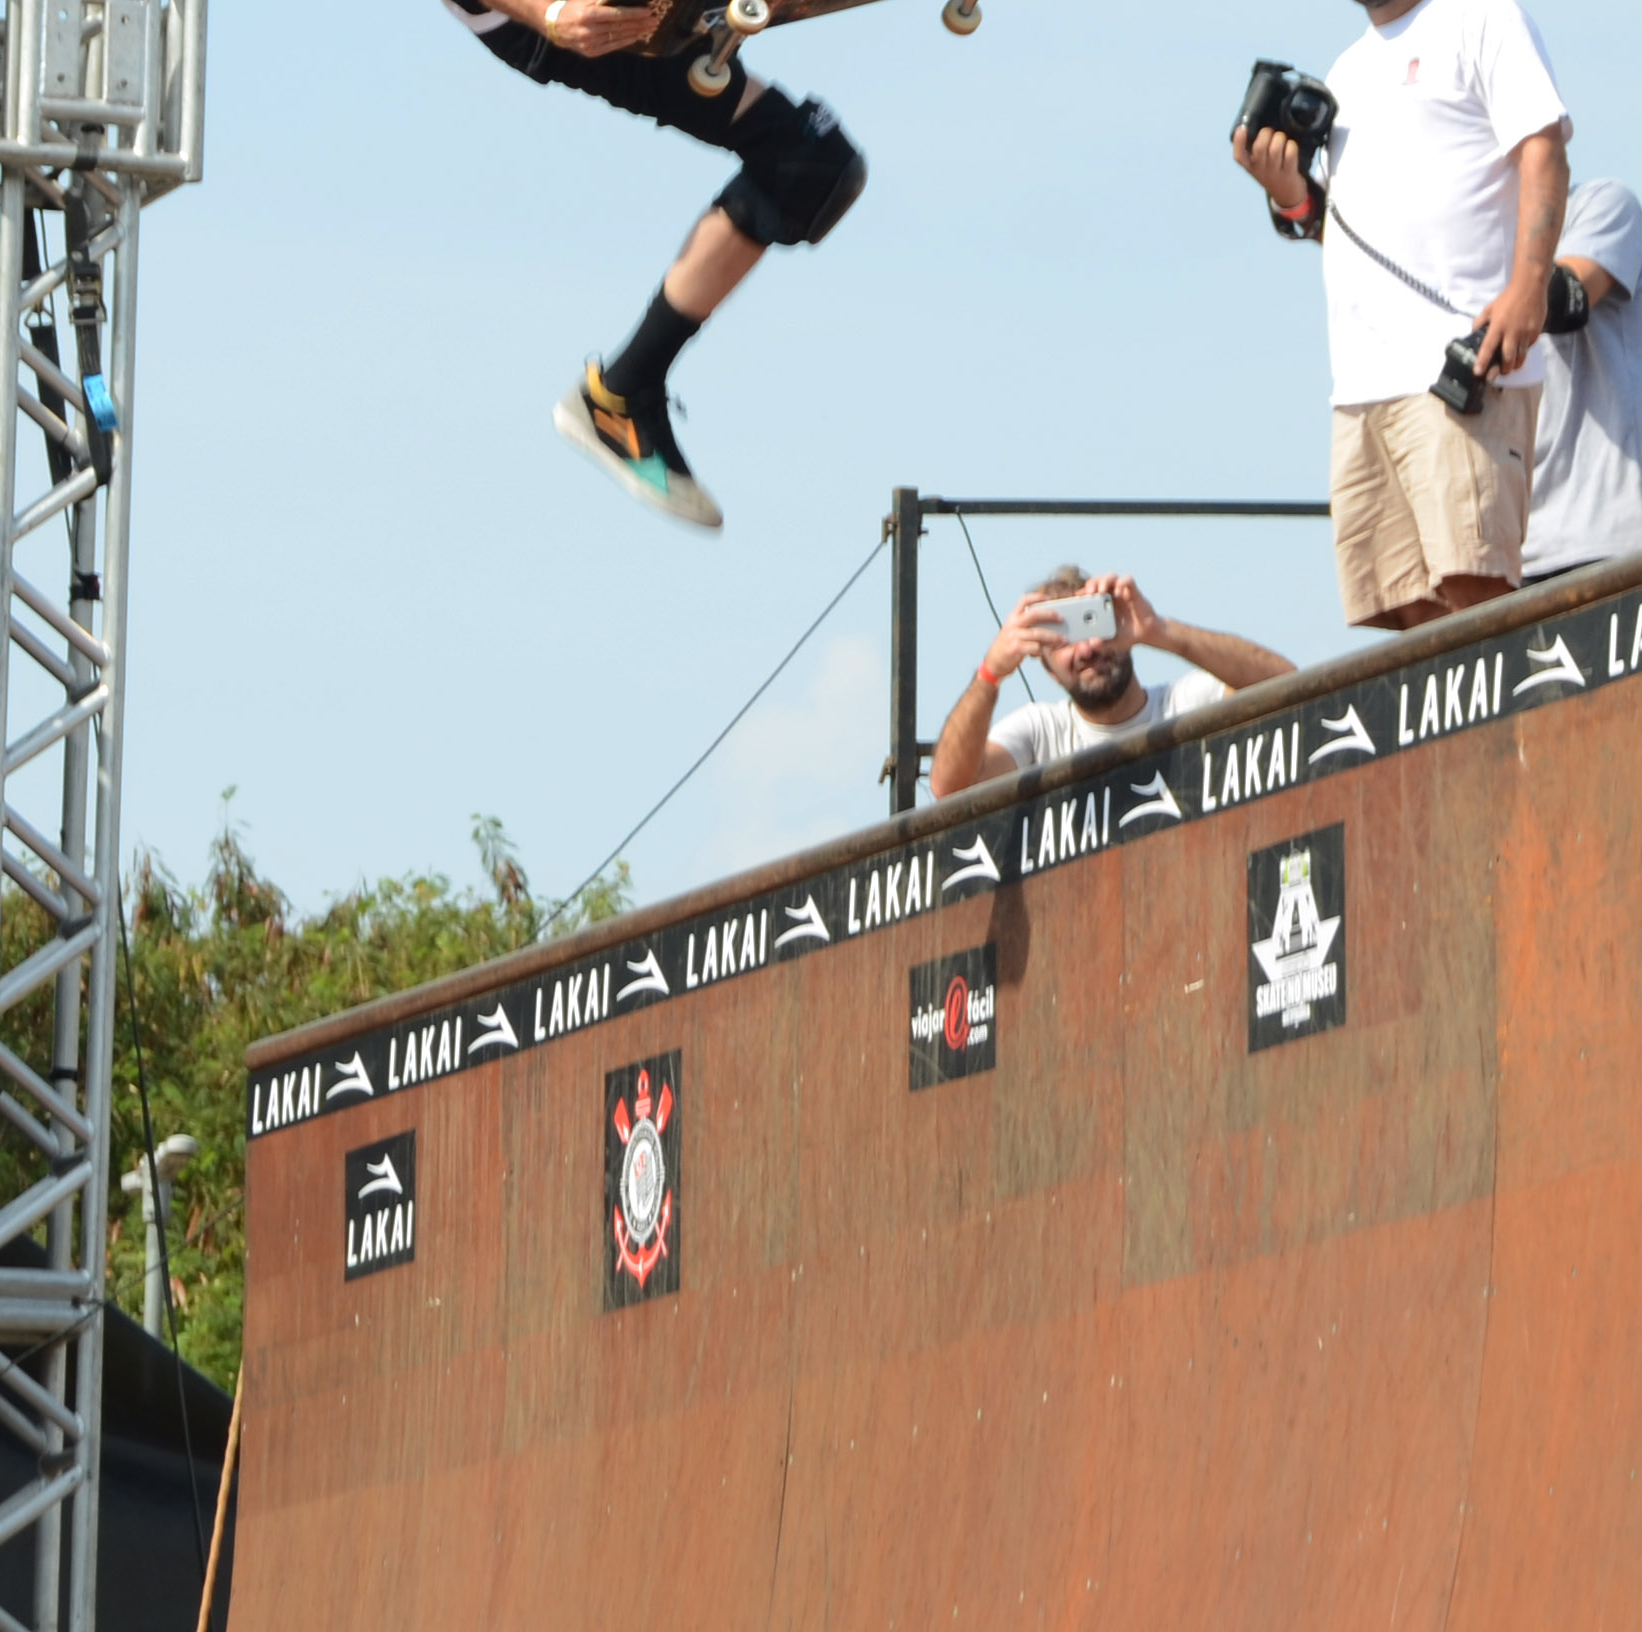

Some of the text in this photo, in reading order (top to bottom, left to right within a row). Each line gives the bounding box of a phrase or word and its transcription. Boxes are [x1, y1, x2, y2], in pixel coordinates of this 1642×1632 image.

[1398, 652, 1503, 746] LAKAI
[1202, 721, 1299, 812] LAKAI
[1020, 787, 1110, 874] LAKAI
[848, 850, 934, 934] LAKAI
[686, 908, 767, 988] LAKAI
[534, 963, 610, 1042] LAKAI
[1256, 979, 1287, 1019] SKATE
[388, 1016, 462, 1090] LAKAI
[252, 1062, 321, 1135] LAKAI
[347, 1199, 414, 1268] LAKAI
